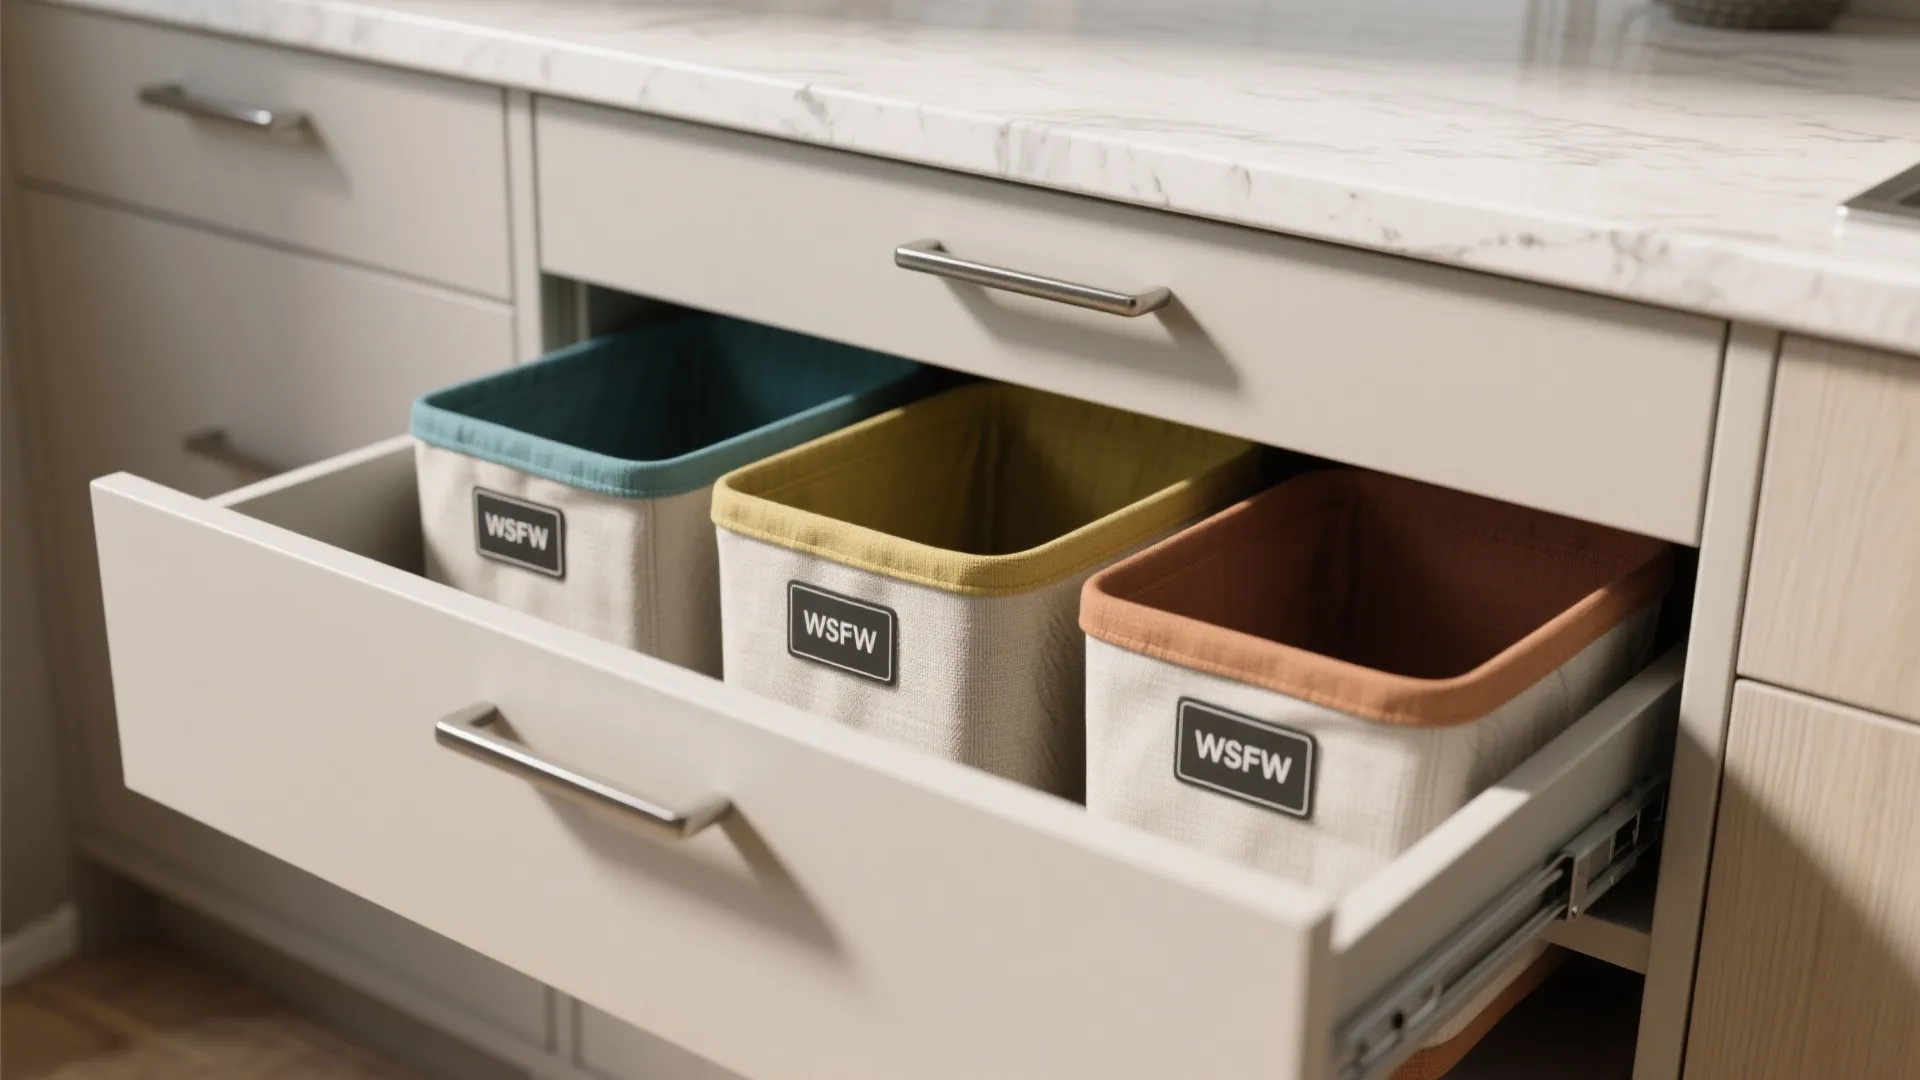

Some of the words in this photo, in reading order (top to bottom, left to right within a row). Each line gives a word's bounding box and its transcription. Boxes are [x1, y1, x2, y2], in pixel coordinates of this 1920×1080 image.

[484, 511, 549, 551] WSFW
[803, 609, 877, 654] WSFW
[1195, 729, 1293, 784] WSFW
